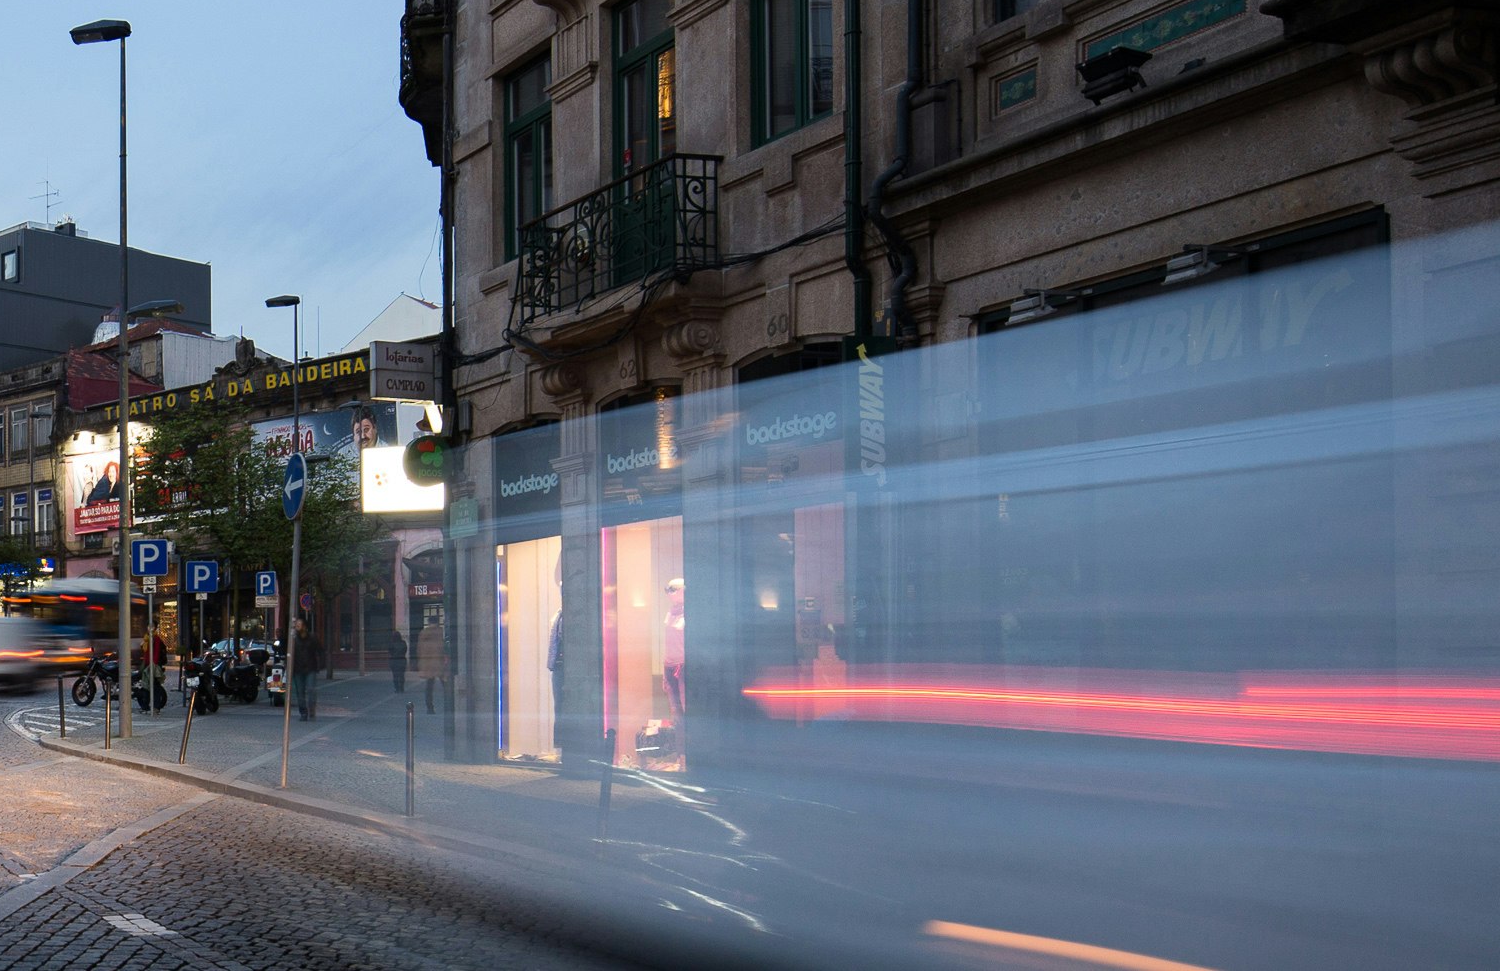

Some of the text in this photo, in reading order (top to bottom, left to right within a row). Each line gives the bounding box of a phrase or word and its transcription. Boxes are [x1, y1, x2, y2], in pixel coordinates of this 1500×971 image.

[766, 313, 788, 337] 60
[385, 347, 424, 365] lotarias
[190, 381, 215, 404] SÁ
[228, 378, 253, 398] DA
[265, 356, 367, 390] BANDEIRA
[619, 359, 637, 379] 62
[856, 343, 888, 487] SUBWAY
[746, 411, 837, 445] backstage
[607, 445, 678, 474] backstae
[500, 472, 558, 497] backstage
[139, 543, 160, 572] P
[193, 565, 211, 590] P
[260, 574, 271, 594] P
[414, 585, 428, 596] TSB
